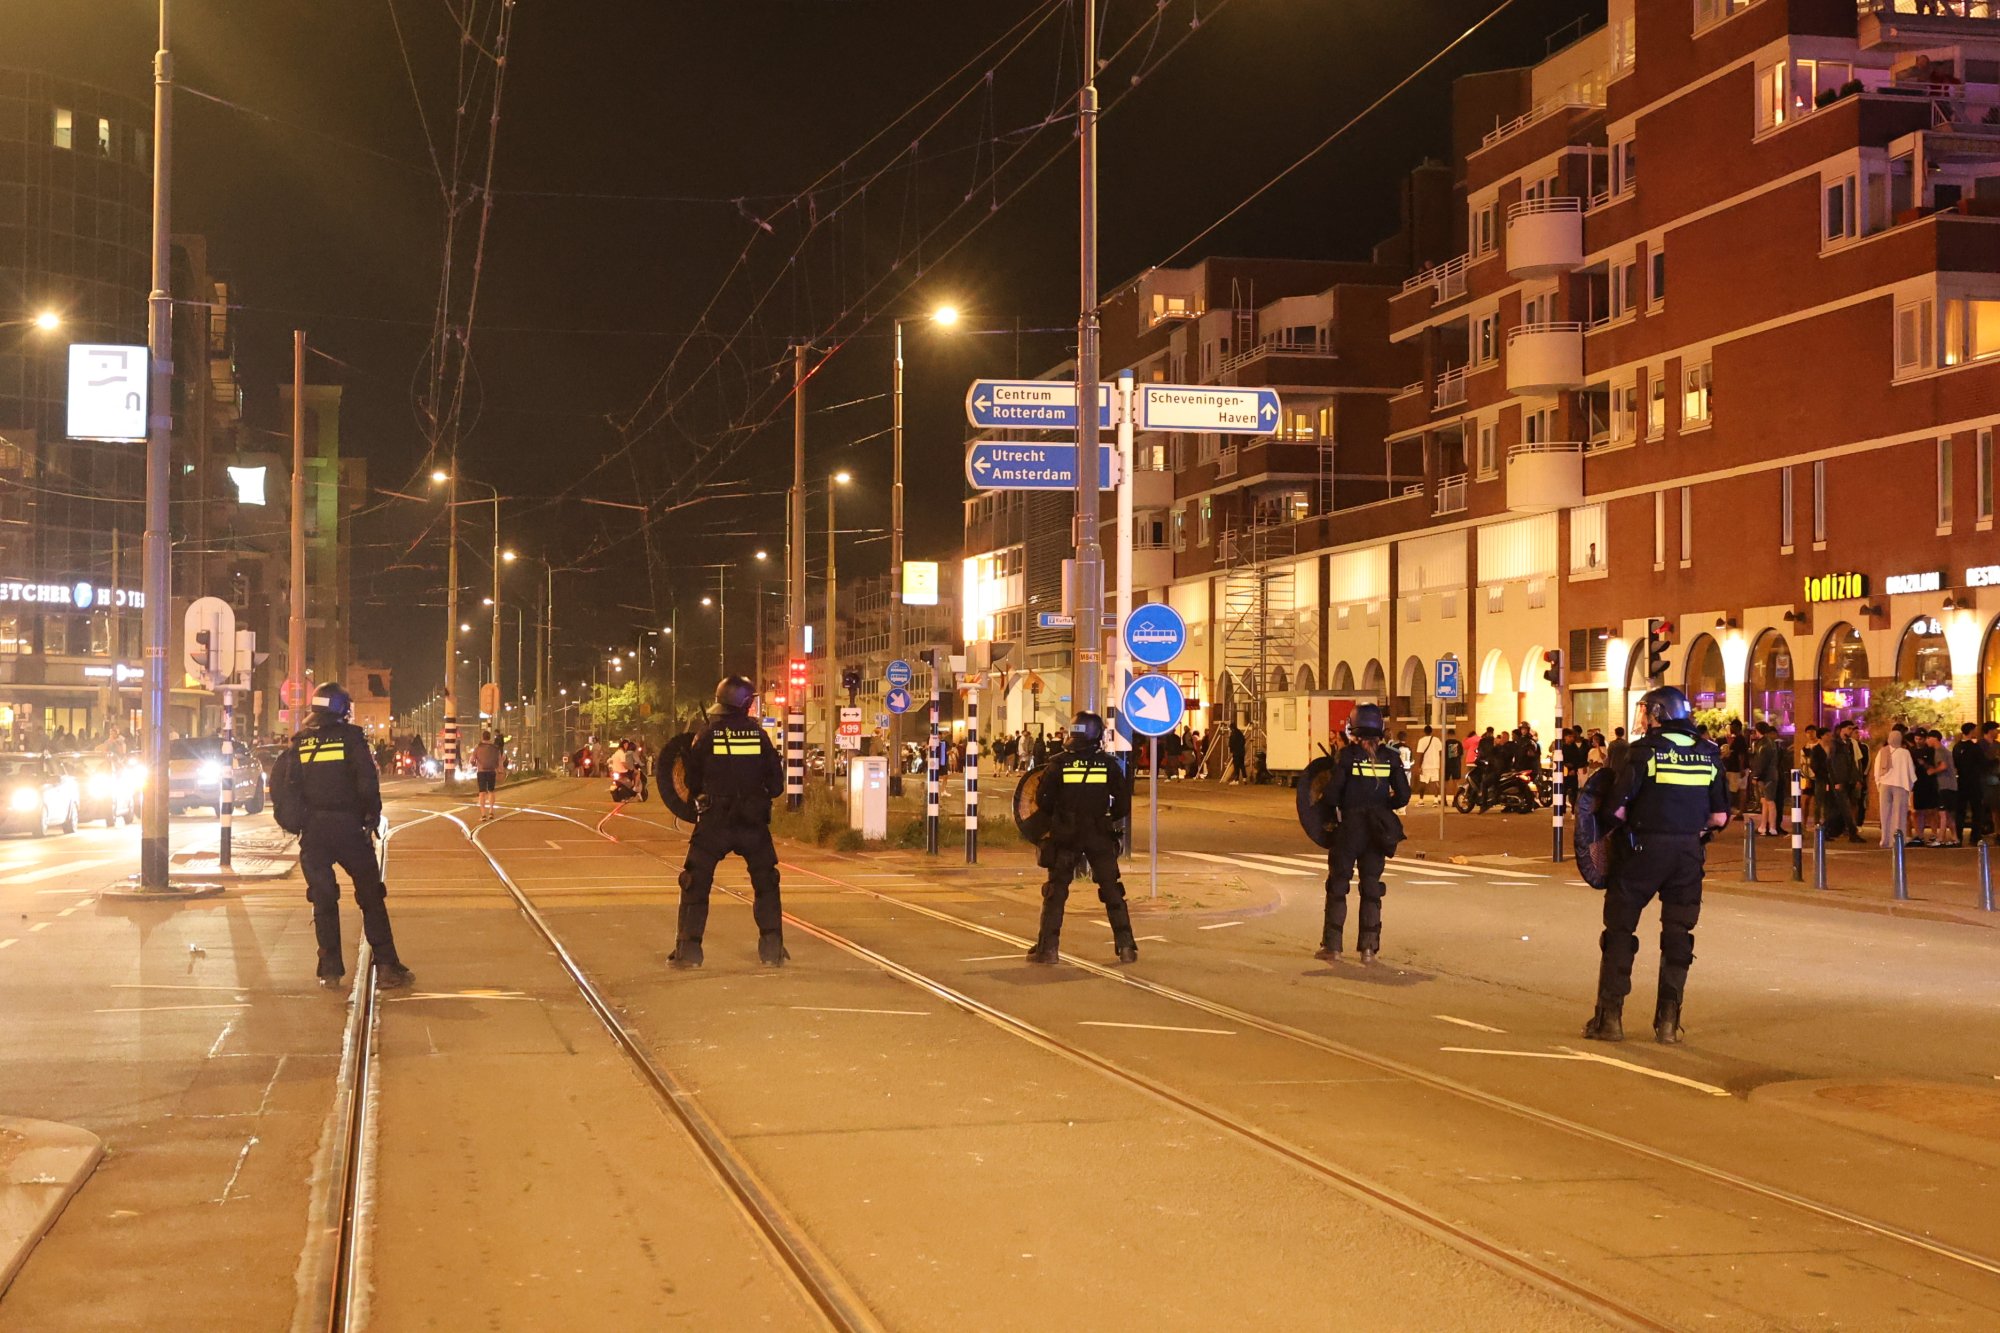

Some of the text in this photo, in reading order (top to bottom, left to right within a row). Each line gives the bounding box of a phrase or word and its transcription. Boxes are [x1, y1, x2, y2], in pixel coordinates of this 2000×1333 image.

[996, 388, 1052, 401] Centrum
[1150, 392, 1244, 407] Scheveningen-
[993, 406, 1066, 419] Rotterdam
[1219, 412, 1257, 424] Haven
[992, 449, 1046, 462] Utrecht
[992, 467, 1071, 480] Amsterdam
[1441, 663, 1454, 682] P
[841, 724, 859, 734] 199
